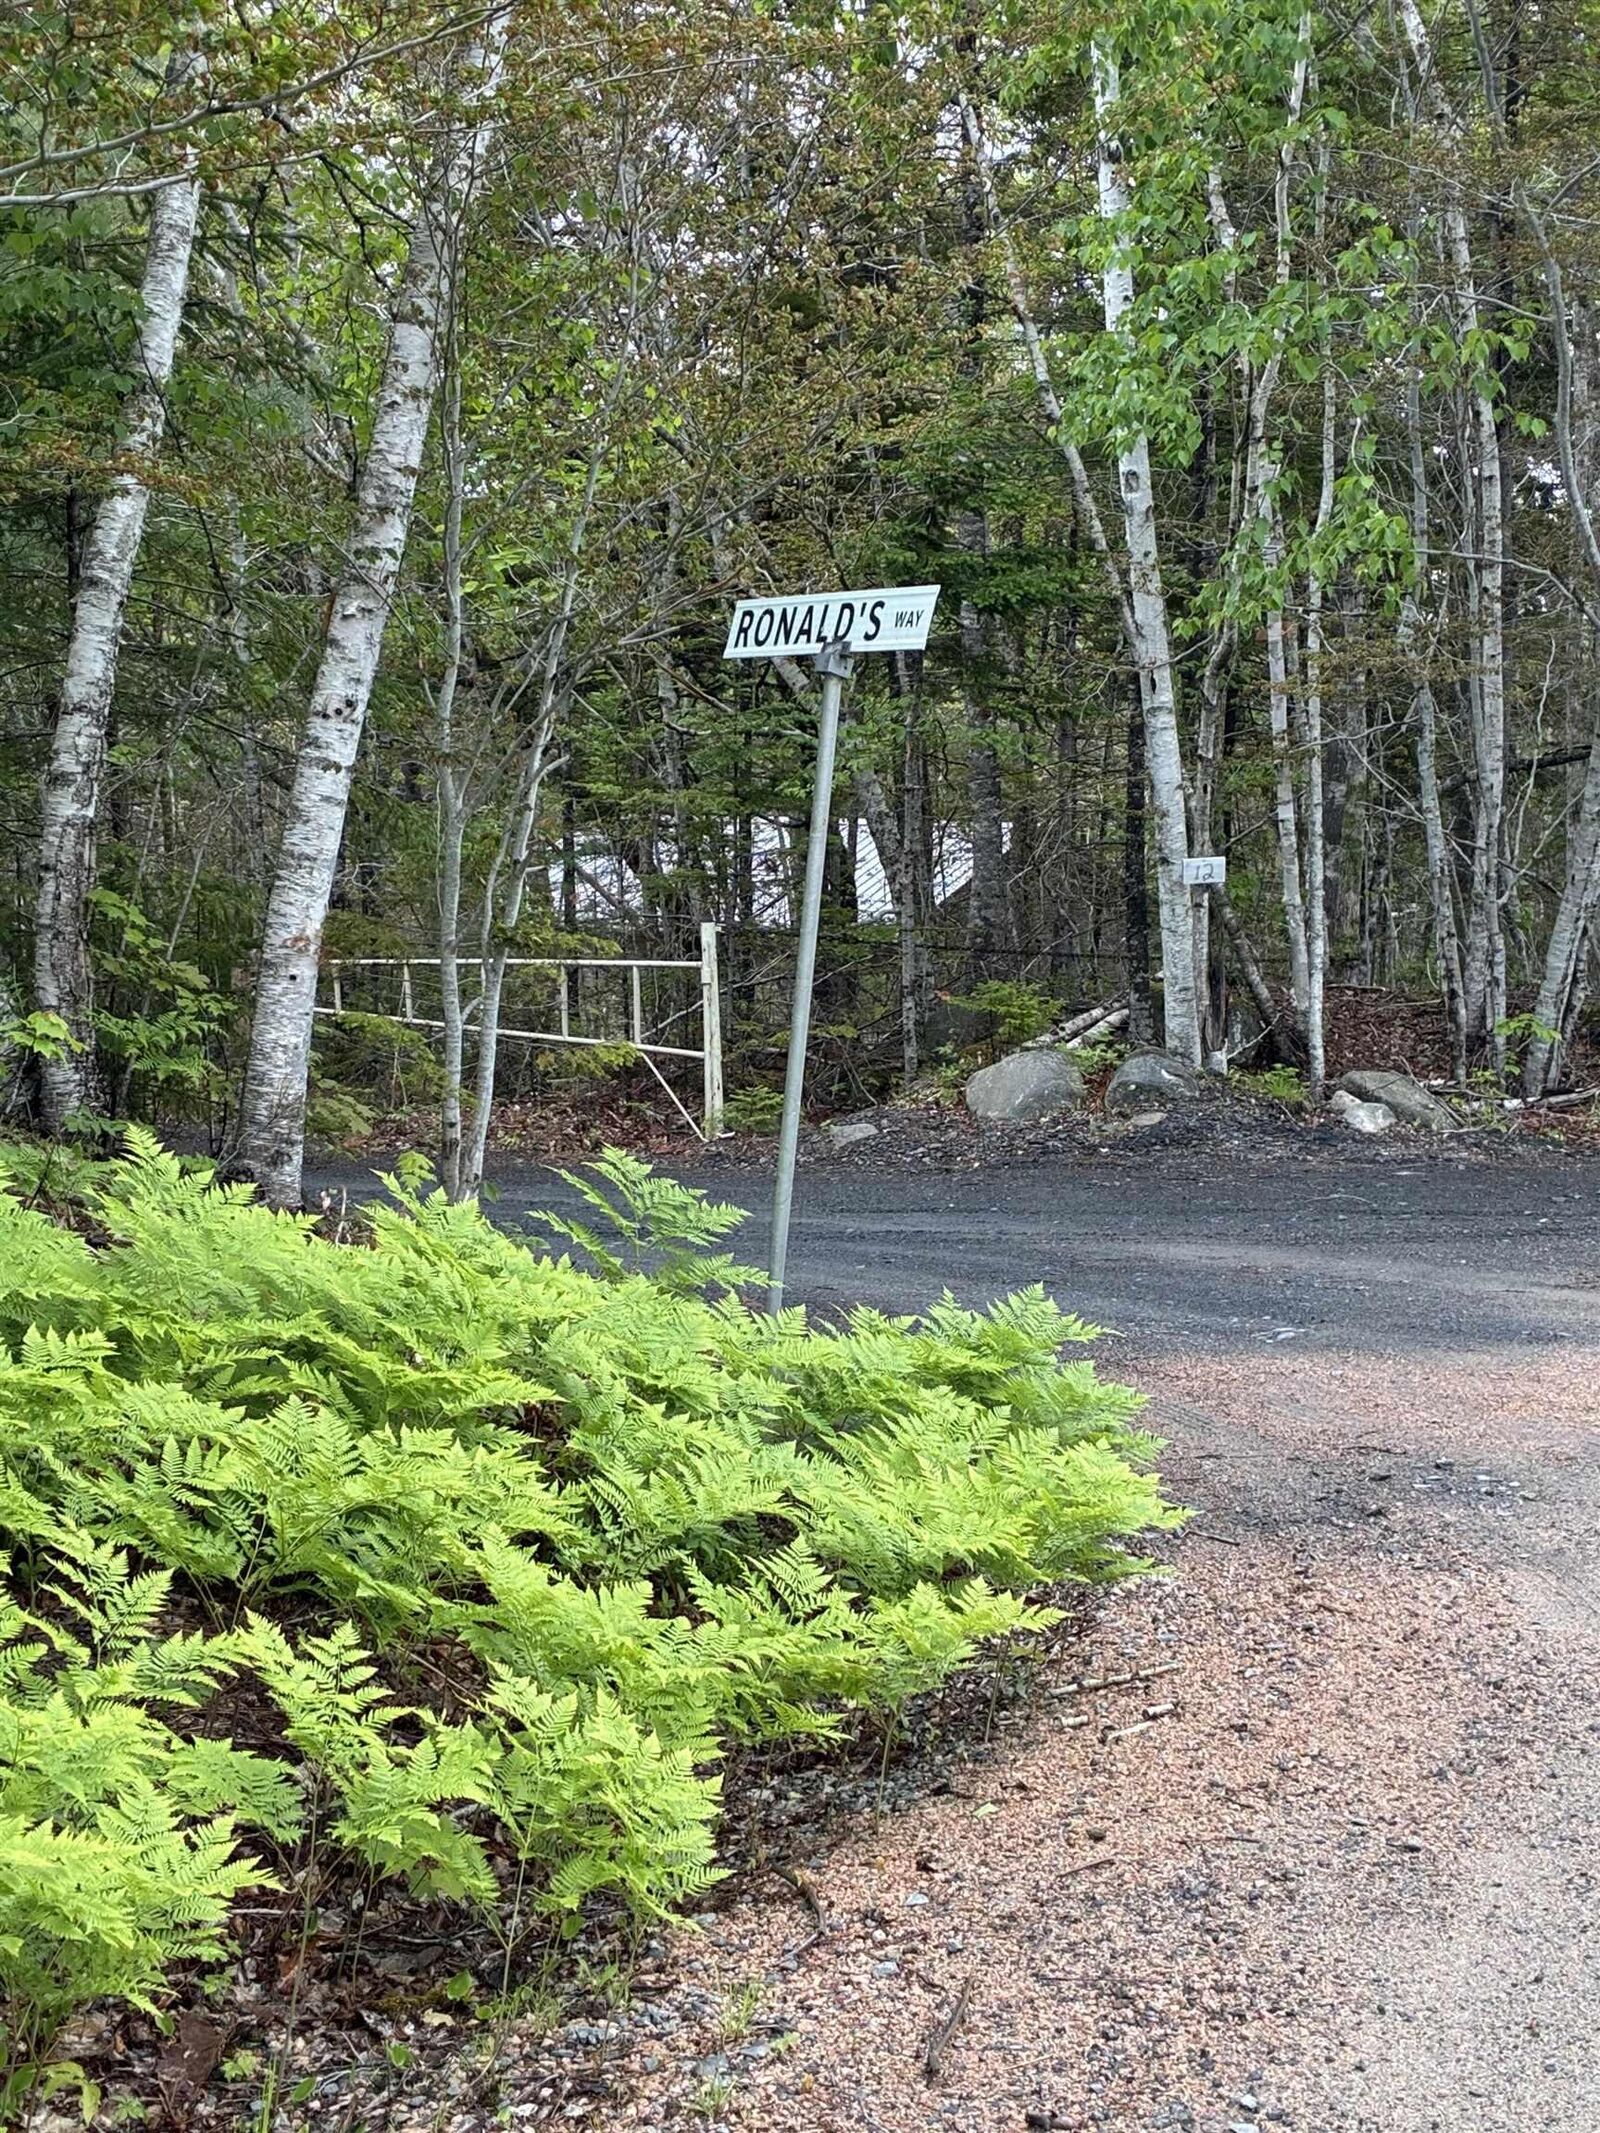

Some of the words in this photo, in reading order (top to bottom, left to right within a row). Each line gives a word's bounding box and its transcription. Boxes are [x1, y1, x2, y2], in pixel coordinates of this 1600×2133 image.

[734, 600, 885, 648] RONALD'S
[894, 609, 925, 629] WAY
[1195, 863, 1214, 881] 12
